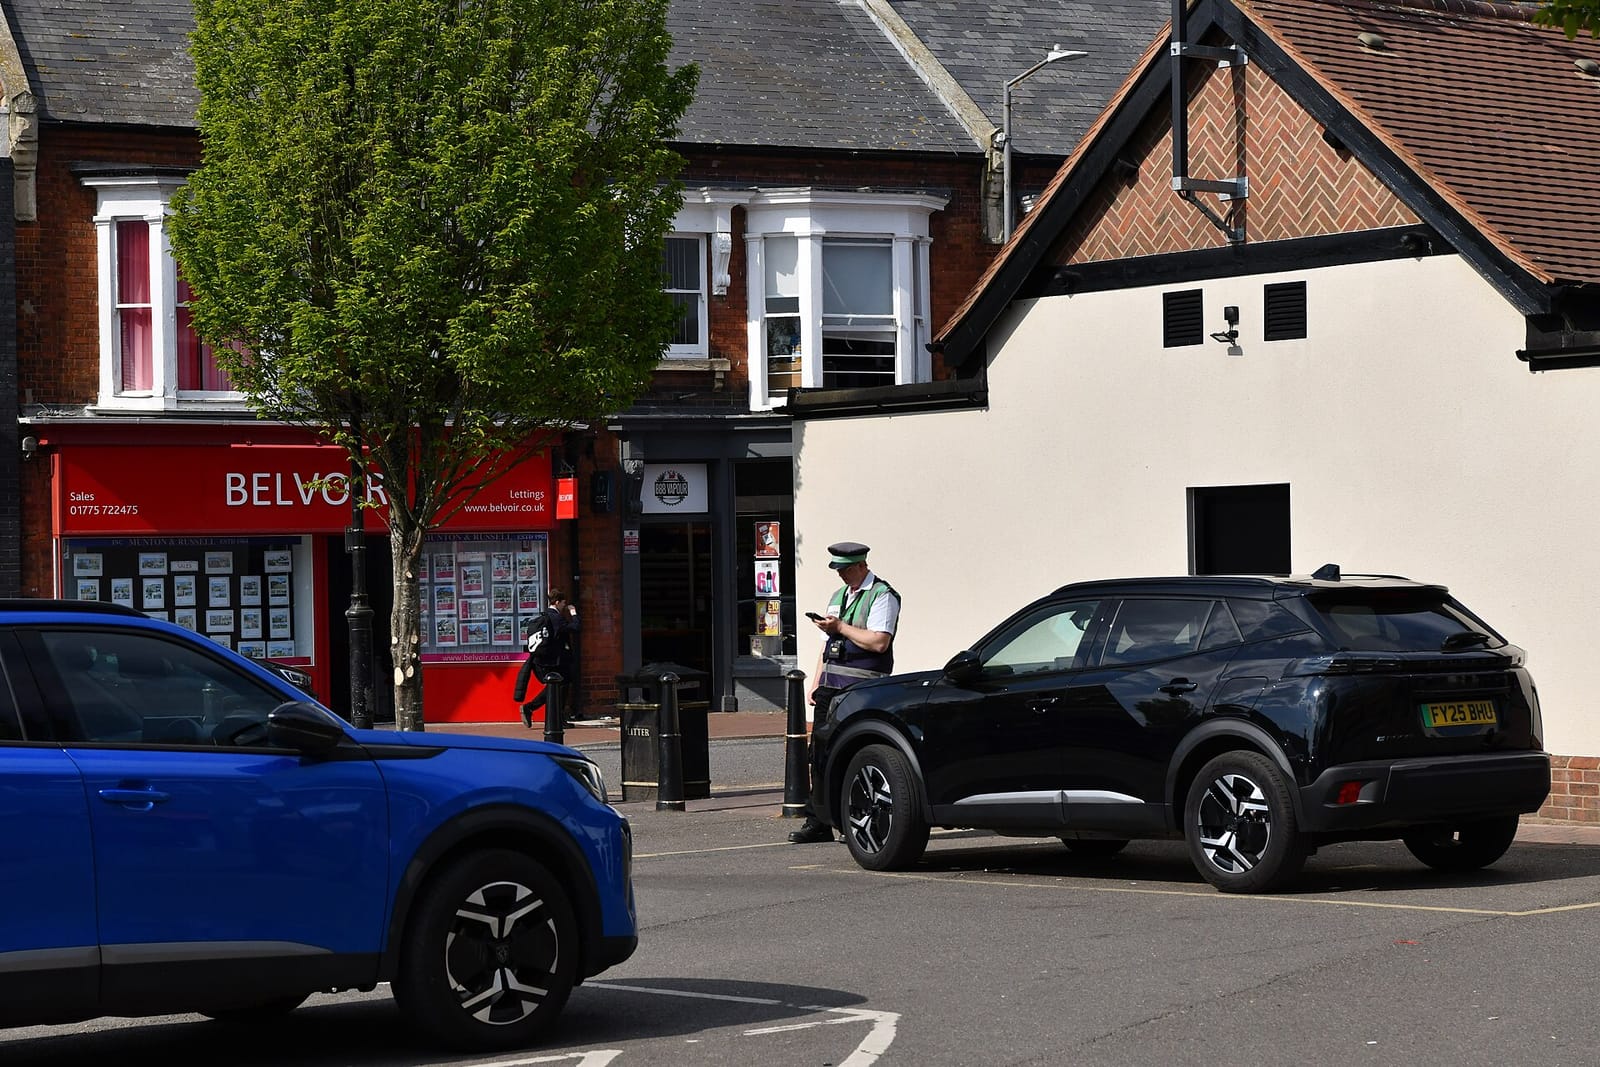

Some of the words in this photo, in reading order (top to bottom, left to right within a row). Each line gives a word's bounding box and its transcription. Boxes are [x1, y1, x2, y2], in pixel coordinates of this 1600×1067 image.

[226, 473, 388, 506] BELVOR
[667, 482, 688, 495] VAPOUR
[70, 491, 95, 501] Sales
[510, 490, 545, 500] Lettings
[70, 505, 100, 515] 01775
[102, 505, 139, 515] 722475
[464, 503, 545, 512] www.belvoir.co.uk
[129, 538, 167, 546] MUNTON
[178, 538, 215, 546] RUSSELL
[473, 533, 511, 541] RUSSELL
[442, 653, 510, 661] www.belvoir.co.uk
[1430, 704, 1466, 723] FY25
[1467, 702, 1493, 721] BHU
